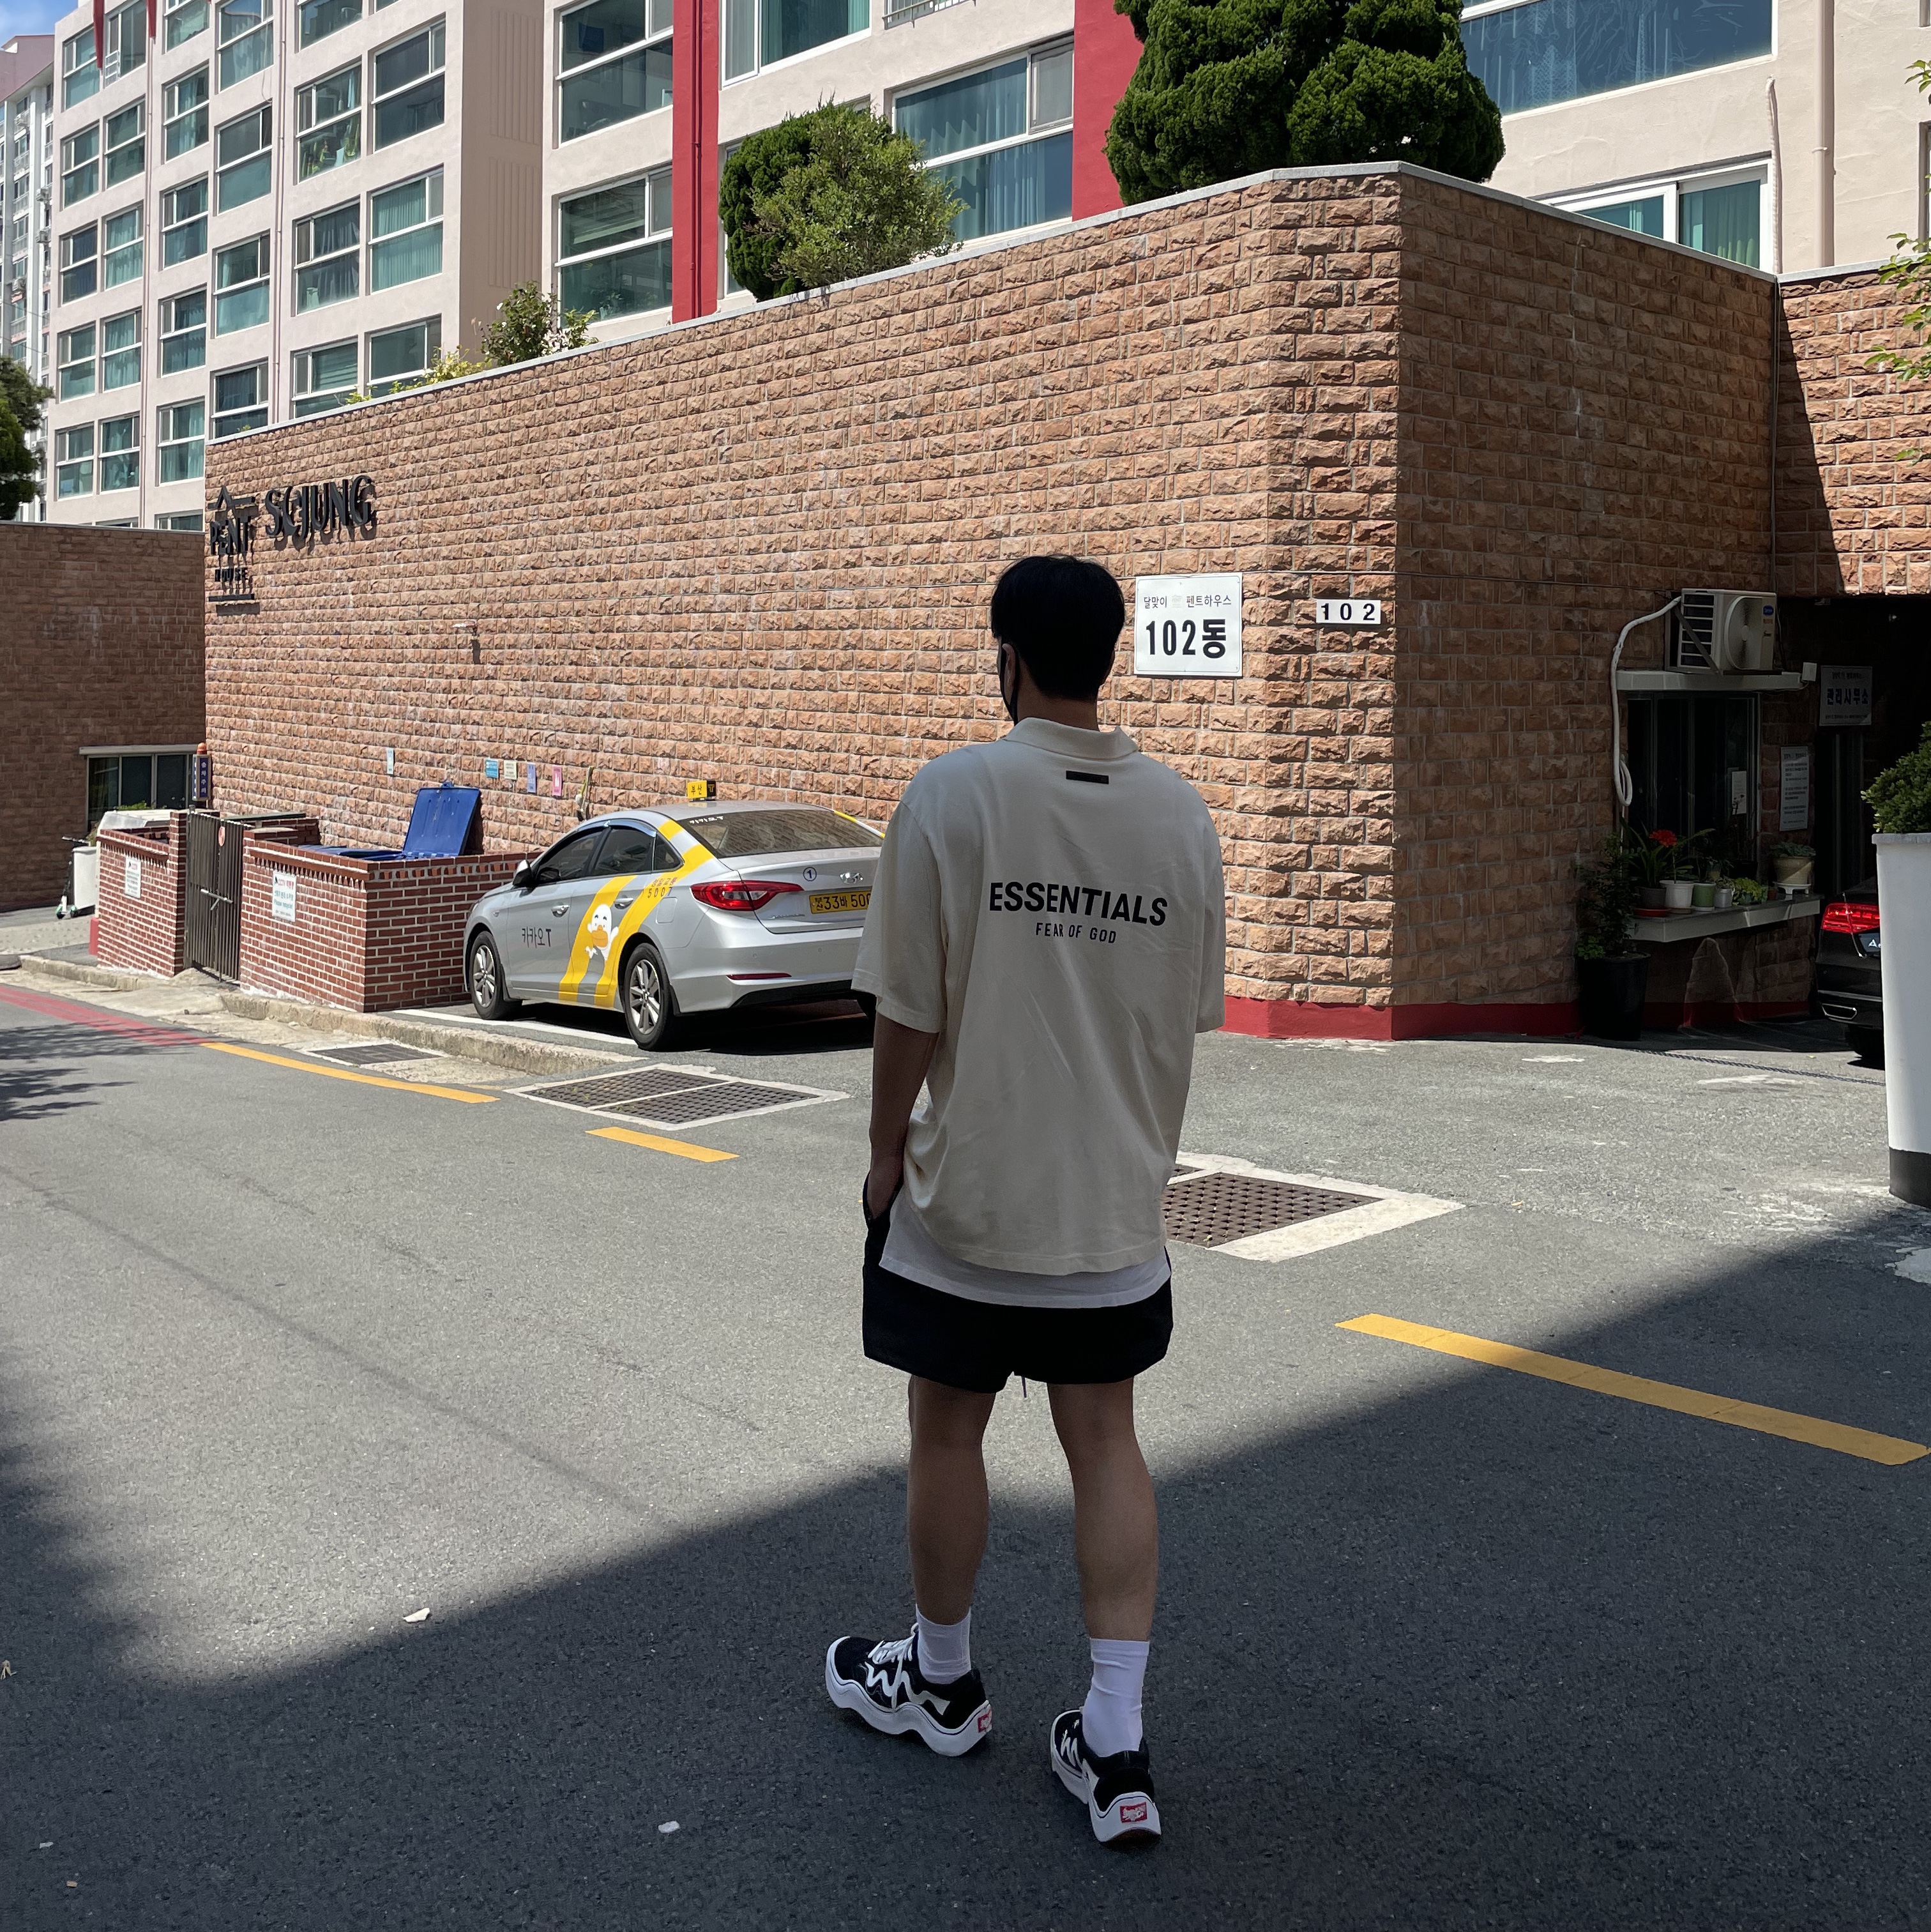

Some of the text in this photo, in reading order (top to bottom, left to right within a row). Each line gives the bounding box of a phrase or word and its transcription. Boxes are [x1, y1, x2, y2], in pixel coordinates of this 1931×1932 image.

[210, 516, 251, 555] PENT
[1144, 595, 1232, 609] 달맞이 펜트하우스
[1321, 603, 1375, 621] 102
[1146, 619, 1227, 658] 102동
[1827, 688, 1868, 705] 관리사무소
[691, 784, 702, 795] 부산
[708, 784, 715, 793] T
[647, 886, 673, 899] 5007
[989, 881, 1168, 926] ESSENTIALS
[1036, 922, 1117, 943] FEAR OF GOD
